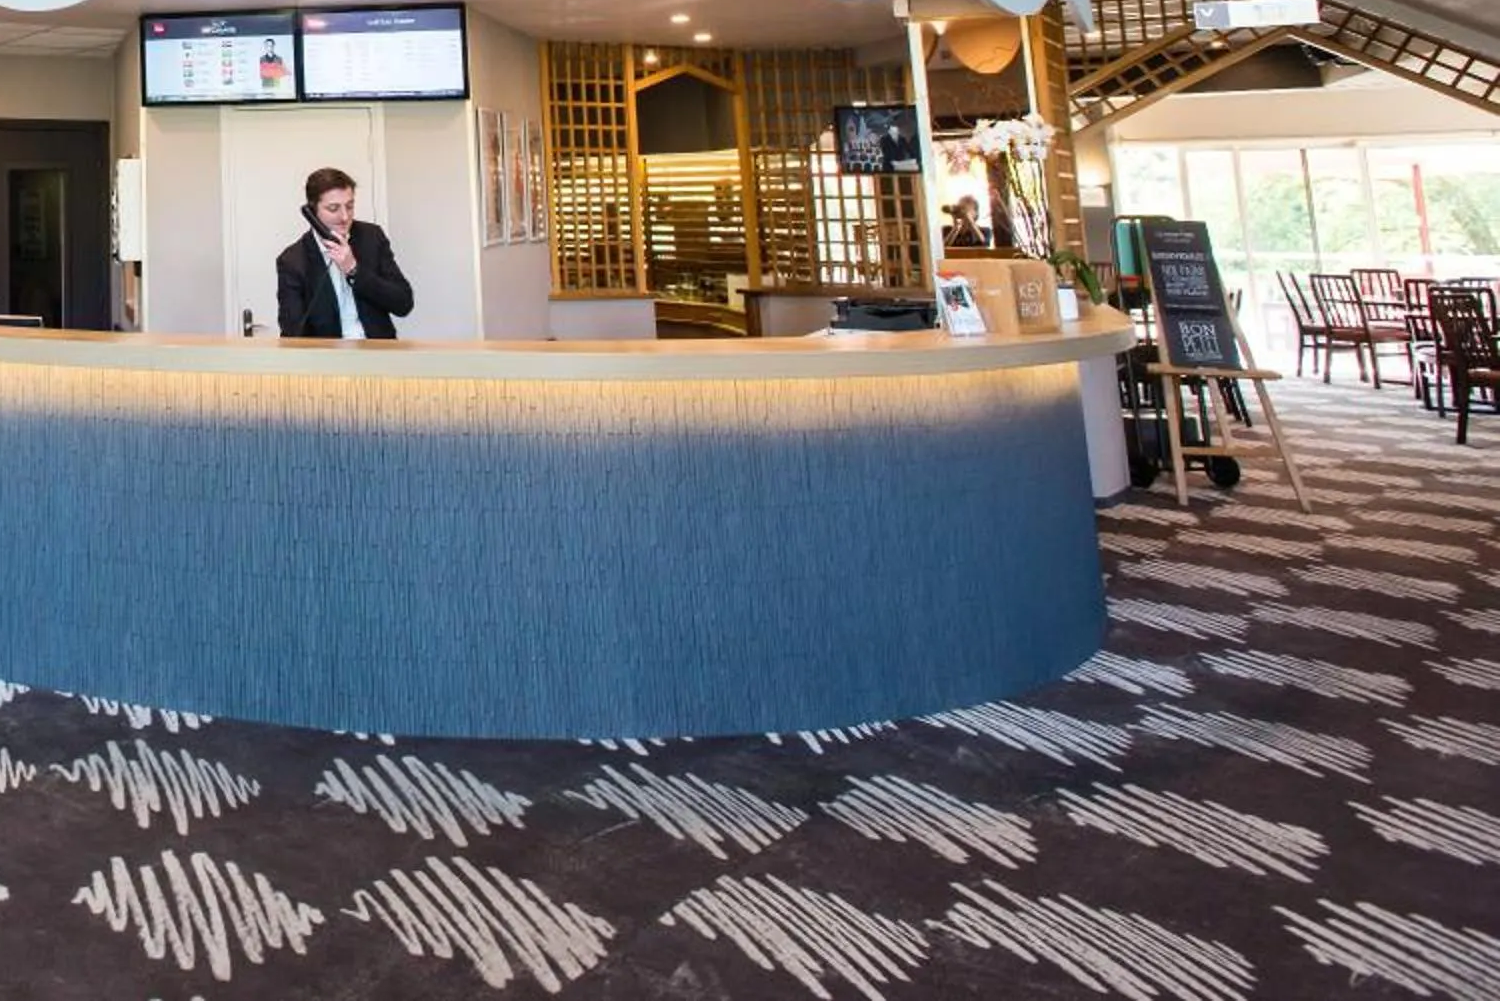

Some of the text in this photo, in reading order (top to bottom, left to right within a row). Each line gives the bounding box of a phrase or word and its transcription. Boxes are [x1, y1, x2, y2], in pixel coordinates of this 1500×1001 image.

[1018, 282, 1043, 299] KEY
[1021, 301, 1045, 317] BOX
[1178, 321, 1216, 336] BON
